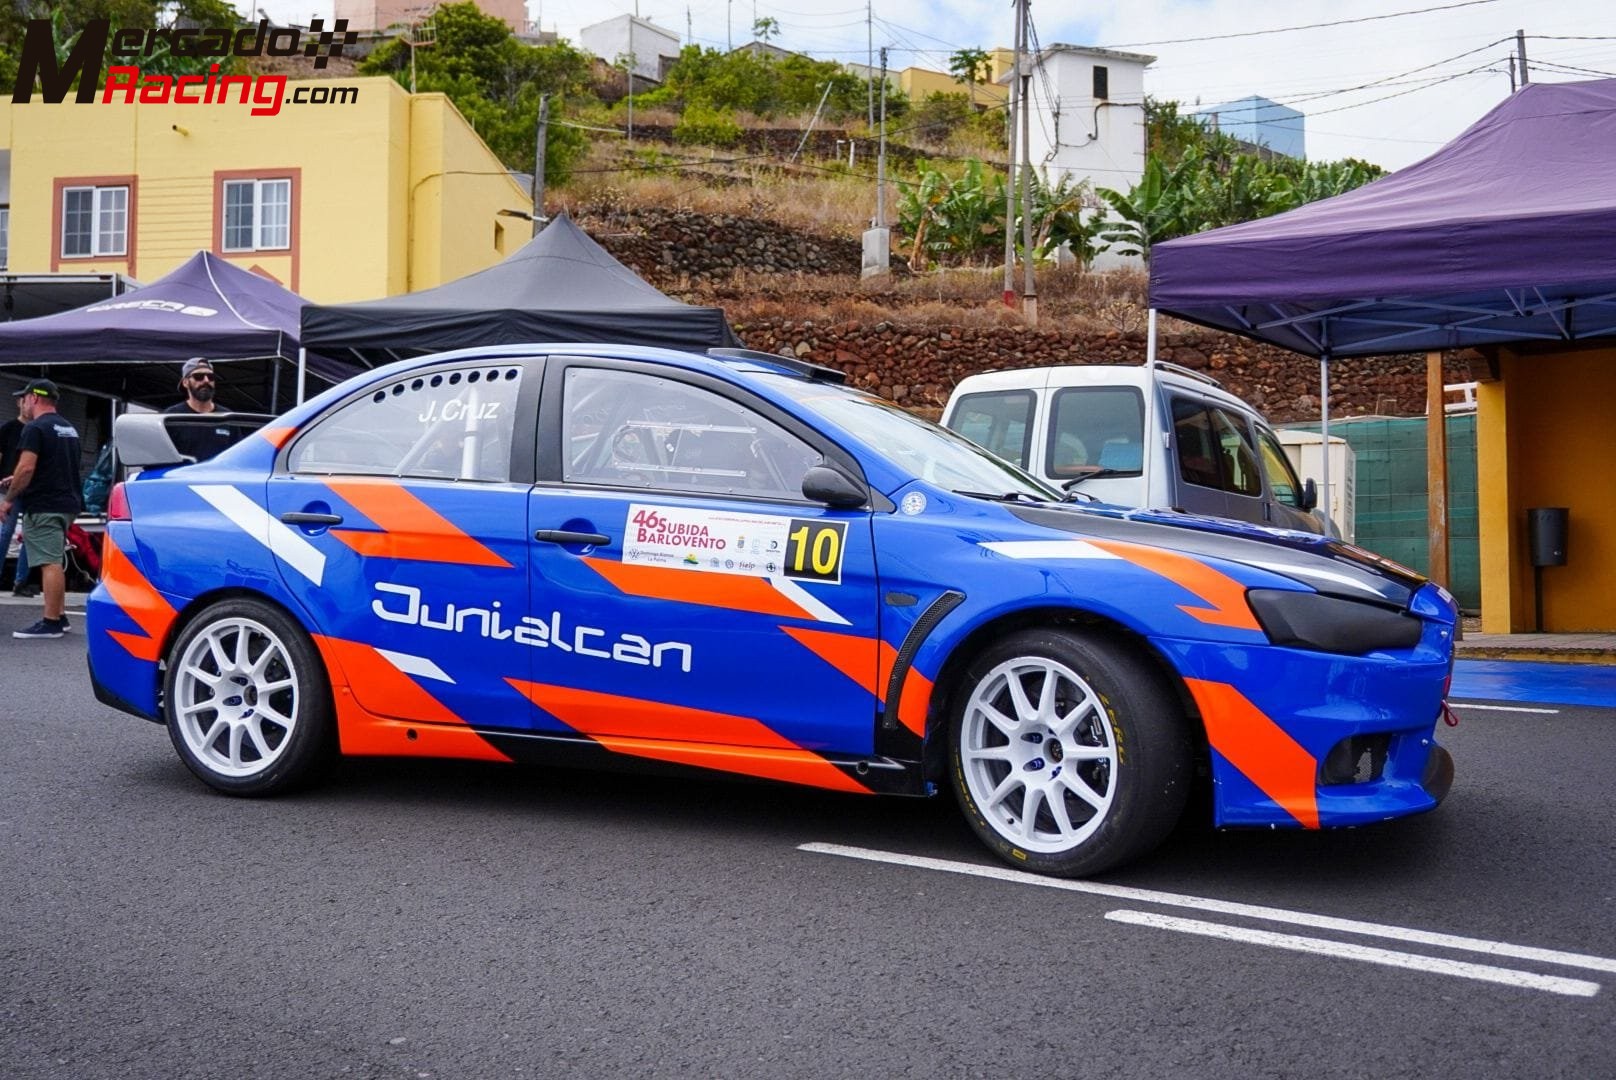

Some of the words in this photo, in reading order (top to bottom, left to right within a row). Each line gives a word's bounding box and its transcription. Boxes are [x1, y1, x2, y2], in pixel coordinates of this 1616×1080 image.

[632, 510, 659, 528] 46
[637, 527, 726, 550] BARLOVENTO
[790, 526, 839, 575] 10
[372, 581, 691, 673] Junialcan
